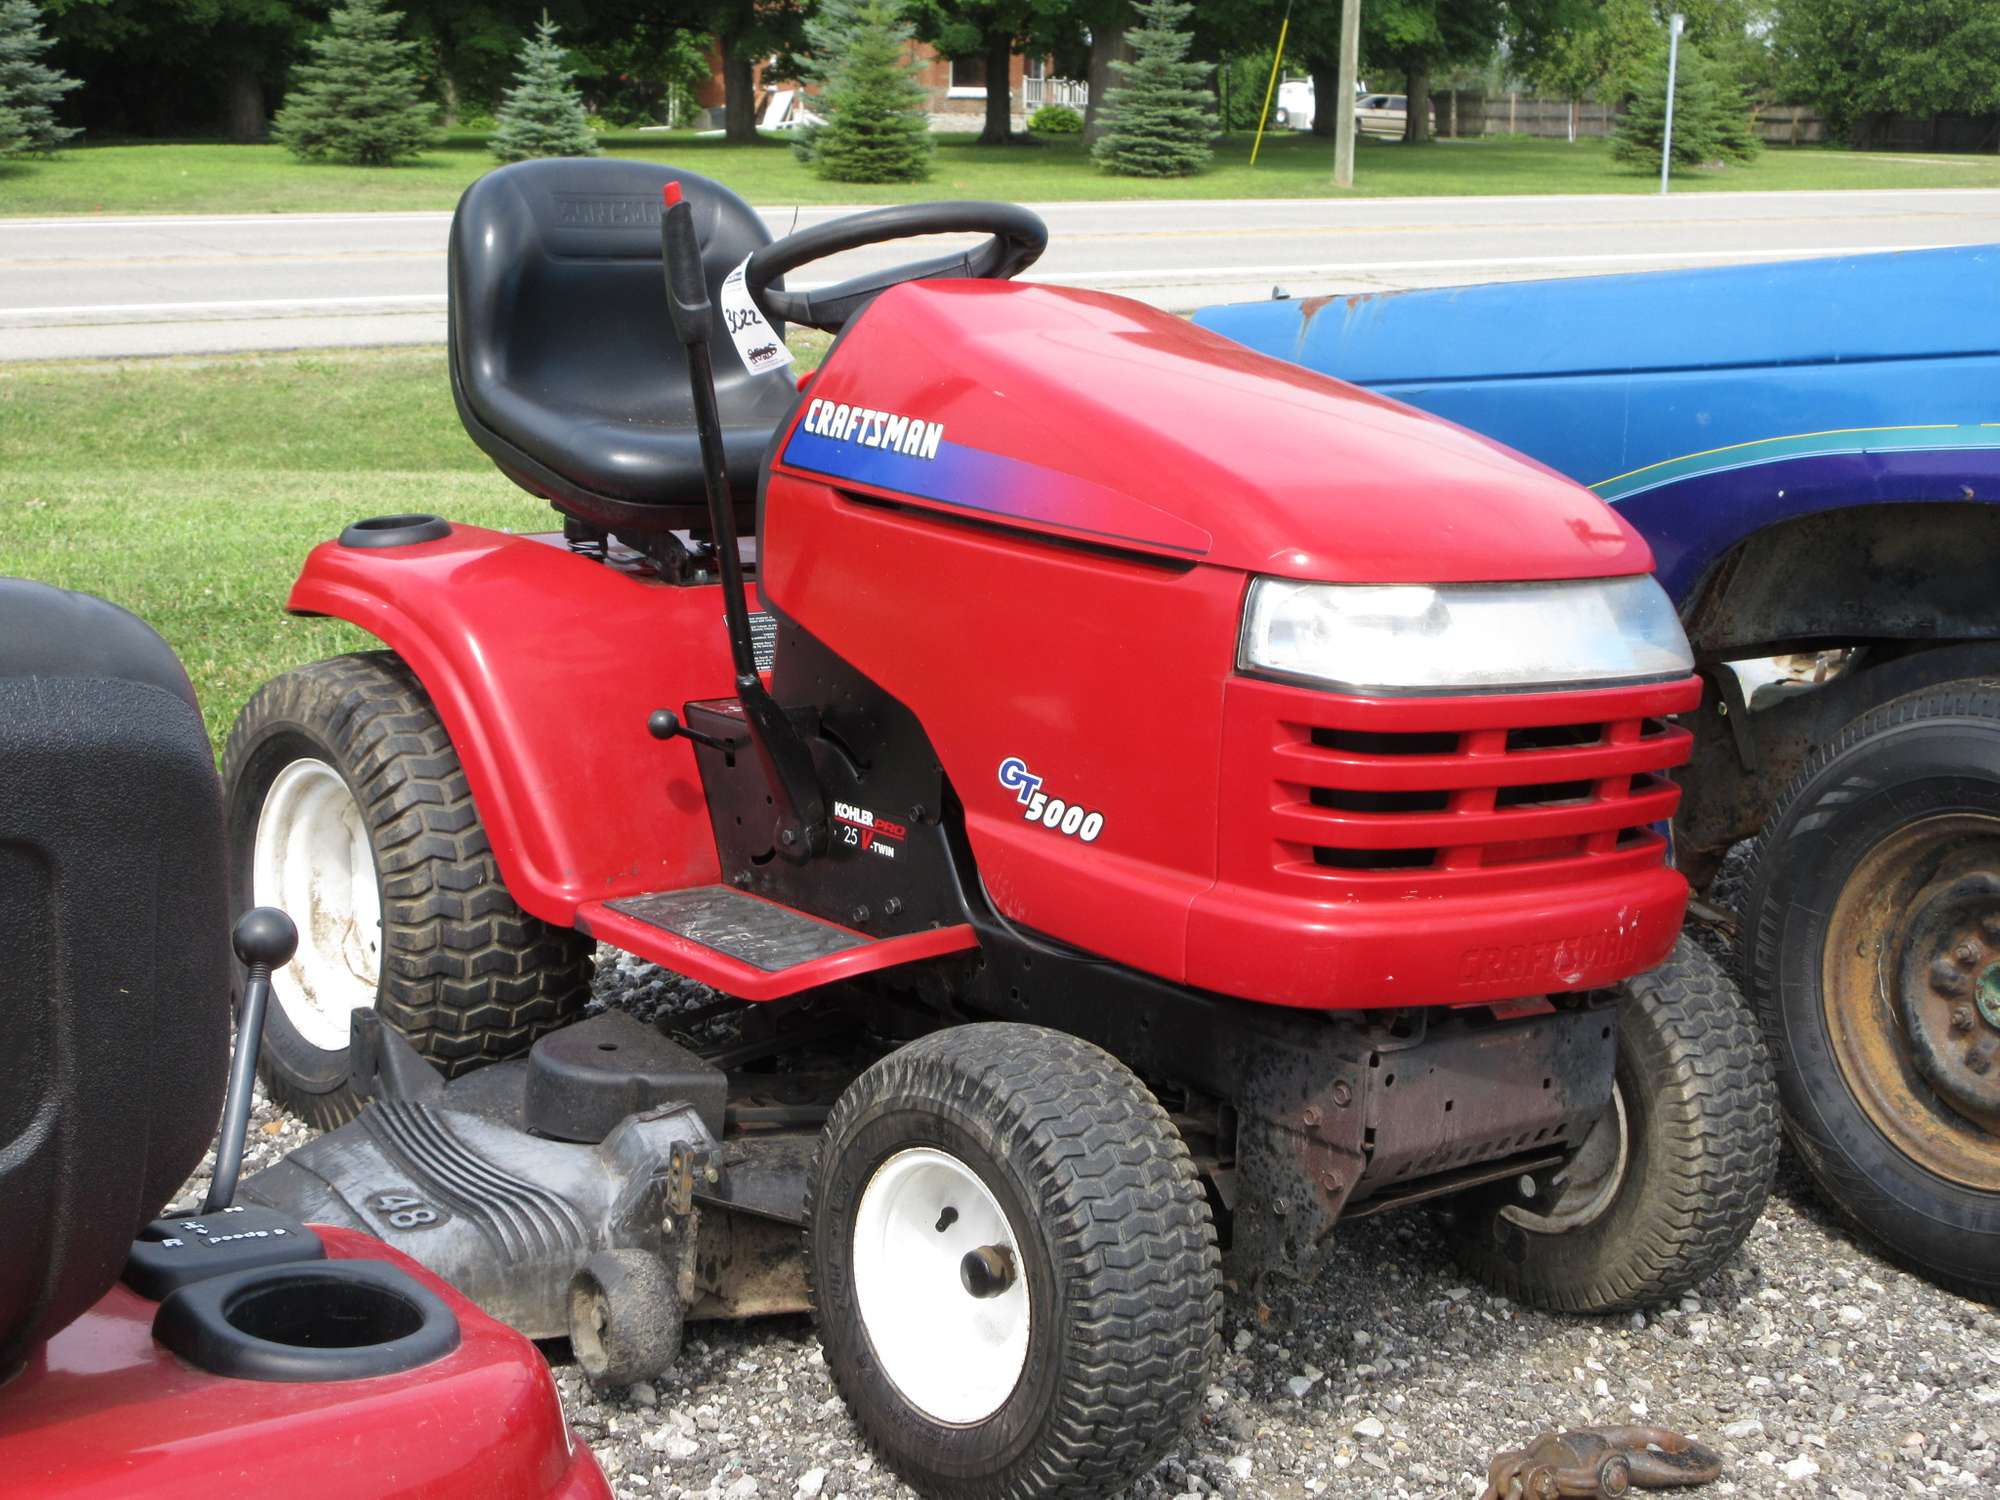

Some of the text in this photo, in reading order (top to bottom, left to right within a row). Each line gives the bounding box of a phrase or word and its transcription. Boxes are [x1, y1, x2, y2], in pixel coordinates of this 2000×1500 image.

[725, 308, 762, 334] 3022
[804, 398, 944, 460] CRAFTSMAN
[834, 801, 906, 836] KOHLER PRO
[1024, 791, 1104, 842] 5000
[843, 825, 858, 845] 25
[377, 1195, 438, 1228] 48
